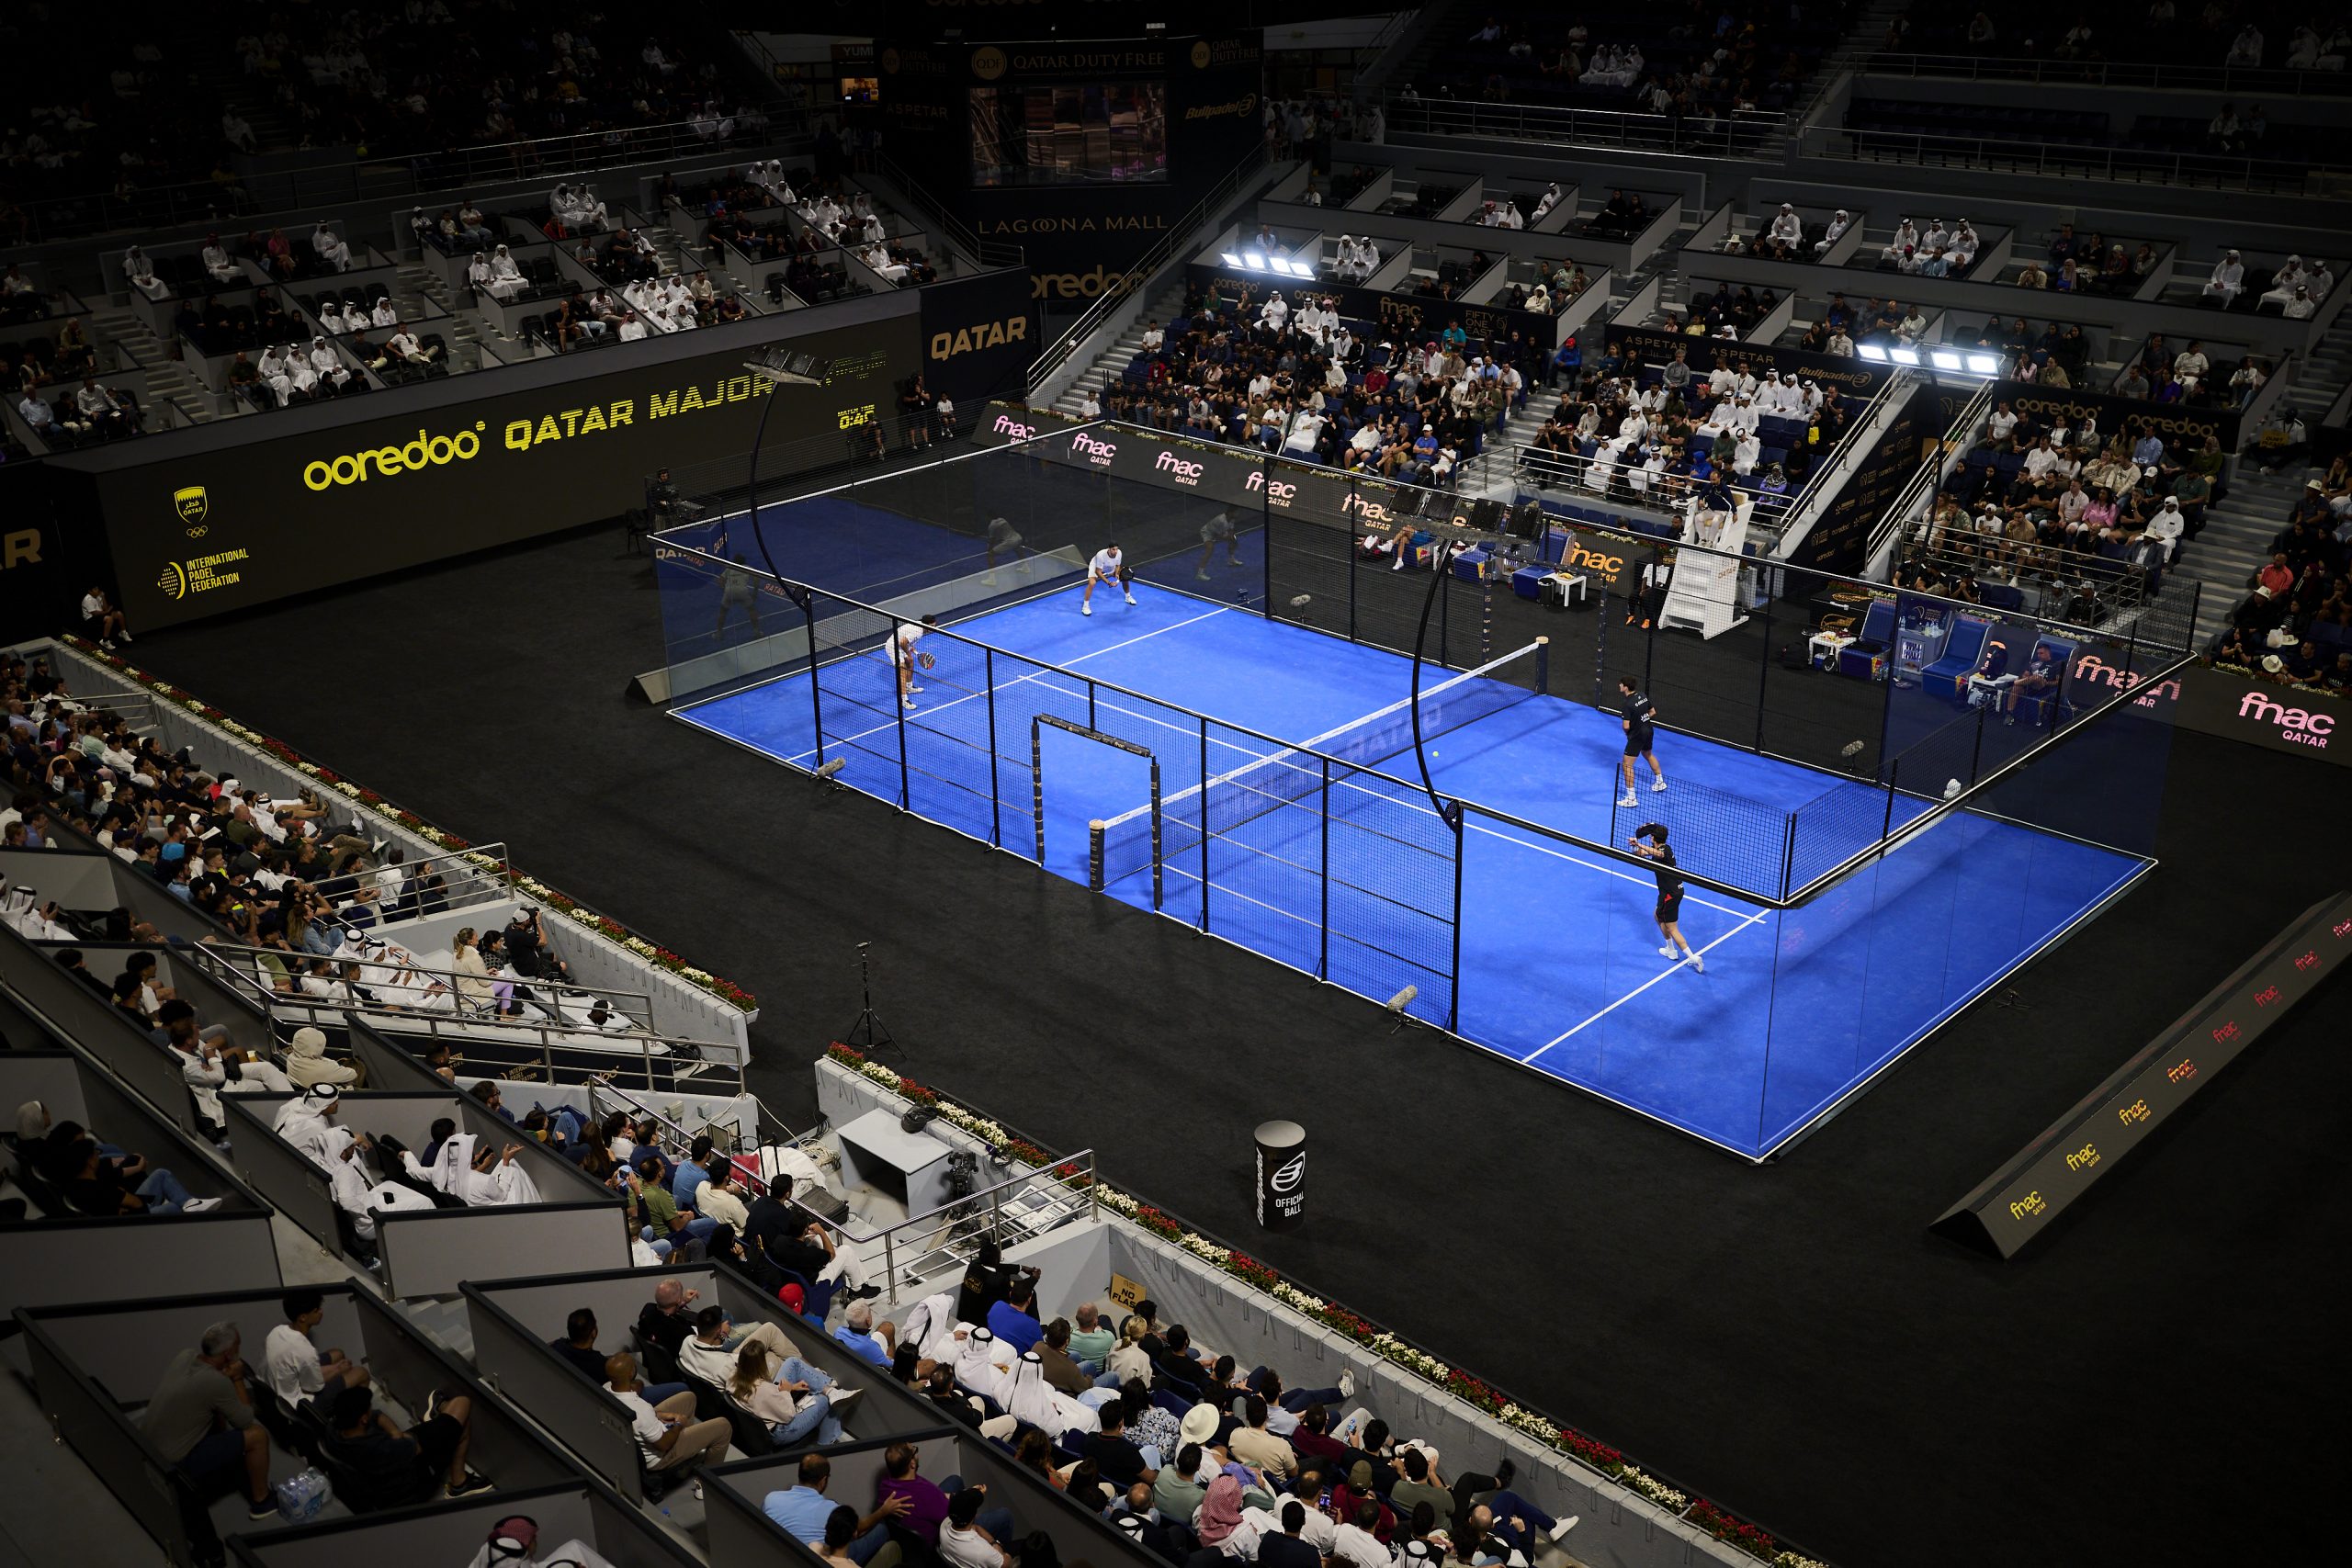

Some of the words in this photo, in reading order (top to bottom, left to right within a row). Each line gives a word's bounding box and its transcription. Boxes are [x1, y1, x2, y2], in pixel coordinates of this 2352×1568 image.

[976, 57, 1002, 69] QDF
[1013, 55, 1069, 70] QATAR
[1074, 53, 1120, 68] DUTY
[1125, 51, 1165, 66] FREE
[886, 103, 948, 118] ASPETAR
[1184, 100, 1240, 120] Bullpadel
[978, 217, 1096, 234] LAGOONA
[1105, 215, 1168, 230] MALL
[1379, 295, 1422, 317] fnac
[1465, 310, 1495, 321] FIFTY
[1465, 318, 1488, 329] ONE
[931, 316, 1027, 361] QATAR
[1625, 334, 1689, 352] ASPETAR
[1710, 345, 1775, 365] ASPETAR
[1797, 367, 1854, 383] Bullpadel
[2016, 397, 2102, 421] ooredoo
[993, 415, 1035, 439] fnac
[304, 421, 485, 491] ooredoo
[505, 399, 634, 451] QATAR
[1071, 432, 1117, 458] fnac
[1090, 456, 1112, 467] QATAR
[1155, 451, 1204, 478] fnac
[1175, 475, 1197, 487] QATAR
[184, 506, 203, 516] QATAR
[1365, 519, 1390, 532] QATAR
[187, 547, 249, 571] INTERNATIONAL
[188, 568, 215, 582] PADEL
[191, 572, 241, 593] FEDERATION
[2238, 692, 2335, 735] fnac
[2282, 729, 2328, 749] QATAR
[2254, 985, 2278, 1008] fnac
[2212, 1021, 2238, 1044] fnac
[2119, 1099, 2147, 1126] fnac
[2066, 1143, 2097, 1171] fnac
[2087, 1154, 2102, 1168] QATAR
[1275, 1190, 1305, 1208] OFFICIAL
[2009, 1190, 2042, 1221] fnac
[2032, 1201, 2048, 1216] QATAR
[1284, 1203, 1302, 1217] BALL
[1112, 1292, 1136, 1309] FLAS
[1121, 1288, 1135, 1300] NO
